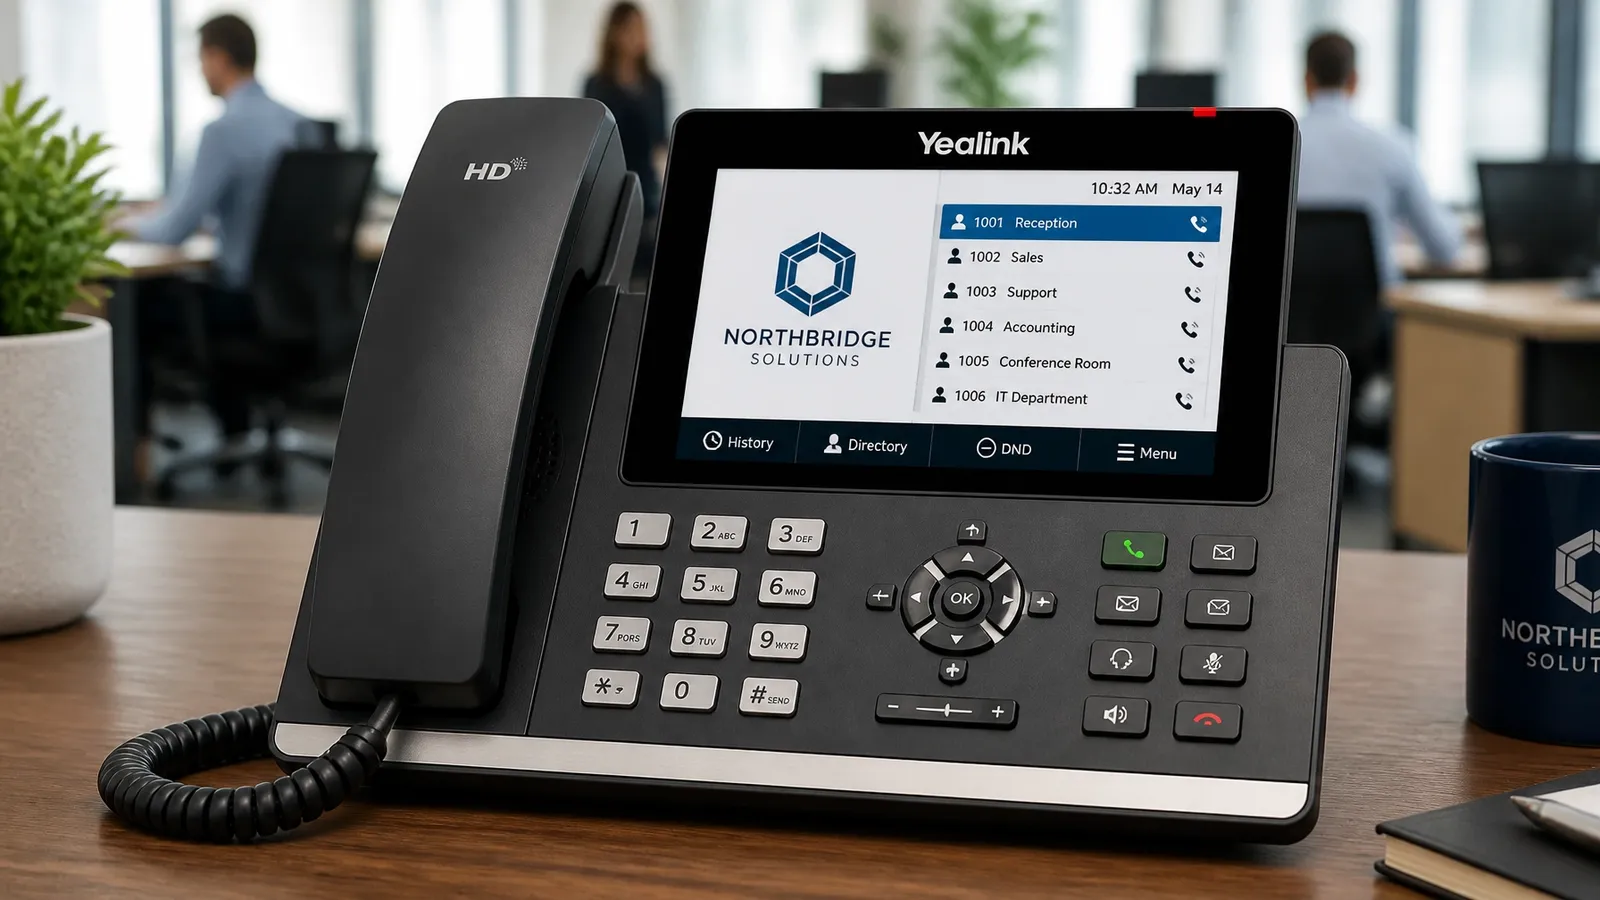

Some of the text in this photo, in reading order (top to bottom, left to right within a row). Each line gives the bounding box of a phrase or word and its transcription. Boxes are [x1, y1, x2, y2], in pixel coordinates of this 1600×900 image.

[917, 131, 1030, 155] Yealink
[463, 162, 512, 180] HD
[1091, 182, 1222, 198] 10:32 AM May 14
[974, 217, 1077, 230] 1001 Reception
[970, 252, 1043, 263] 1002 Sales
[966, 286, 1057, 300] 1003 Support
[962, 321, 1075, 336] 1004 Accounting
[724, 329, 891, 347] NORTHBRIDGE
[750, 353, 859, 366] SOLUTIONS
[958, 356, 1110, 369] 1005 Conference Room
[955, 390, 1088, 405] 1006 IT Department
[728, 437, 773, 451] History
[848, 439, 907, 455] Directory
[1001, 444, 1031, 455] DND
[1139, 447, 1176, 459] Menu
[630, 520, 638, 536] 1
[701, 522, 715, 539] 2
[778, 525, 792, 542] 3
[614, 571, 629, 588] 4
[692, 574, 706, 591] 5
[769, 578, 783, 595] 6
[950, 593, 973, 604] OK
[605, 623, 620, 641] 7
[681, 627, 696, 645] 8
[759, 631, 773, 648] 9
[674, 681, 689, 699] 0
[749, 686, 767, 703] #
